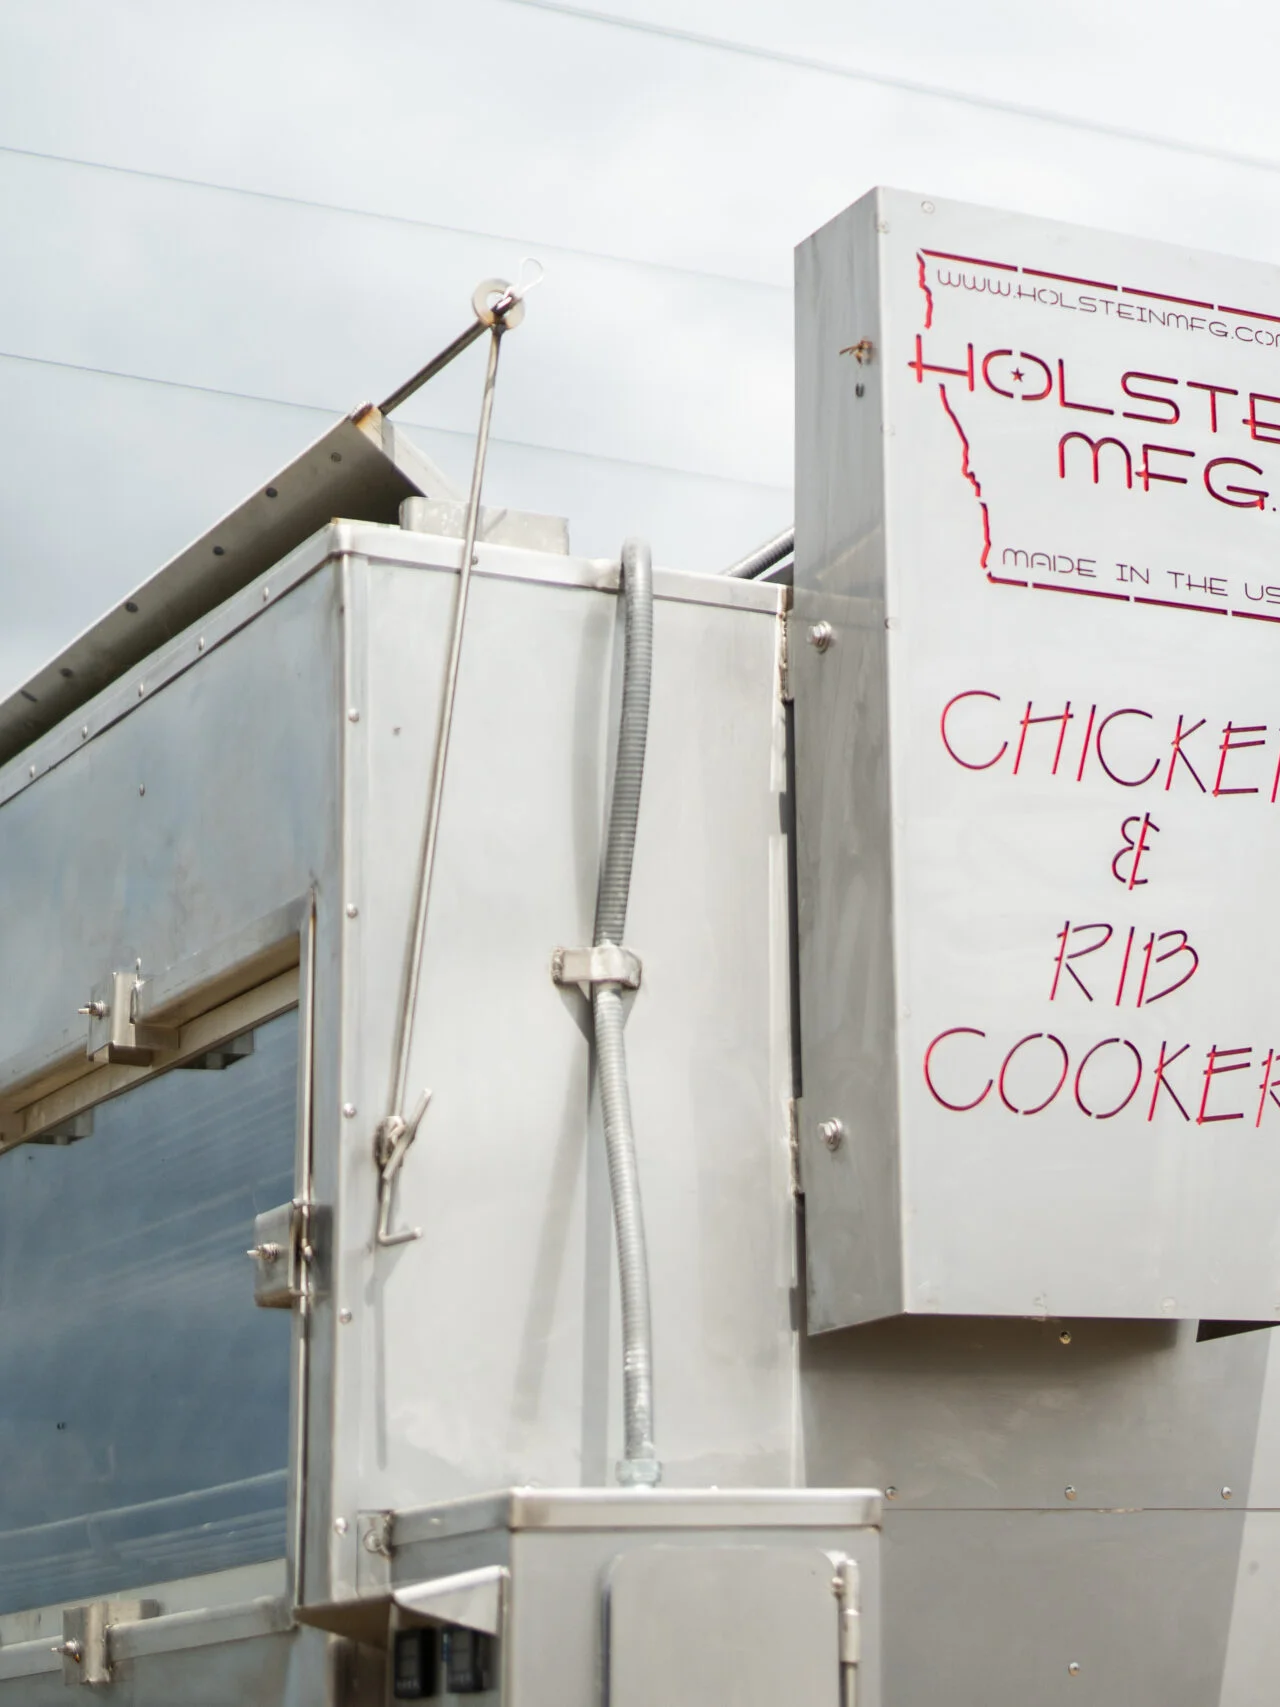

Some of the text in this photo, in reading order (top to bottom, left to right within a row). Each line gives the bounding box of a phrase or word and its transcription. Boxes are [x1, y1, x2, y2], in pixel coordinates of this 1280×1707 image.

[1058, 431, 1278, 513] MFG.
[1002, 548, 1098, 579] MADE
[1115, 563, 1150, 585] IN
[1167, 570, 1229, 597] THE
[1111, 812, 1160, 890] &
[1048, 920, 1199, 1008] RIB
